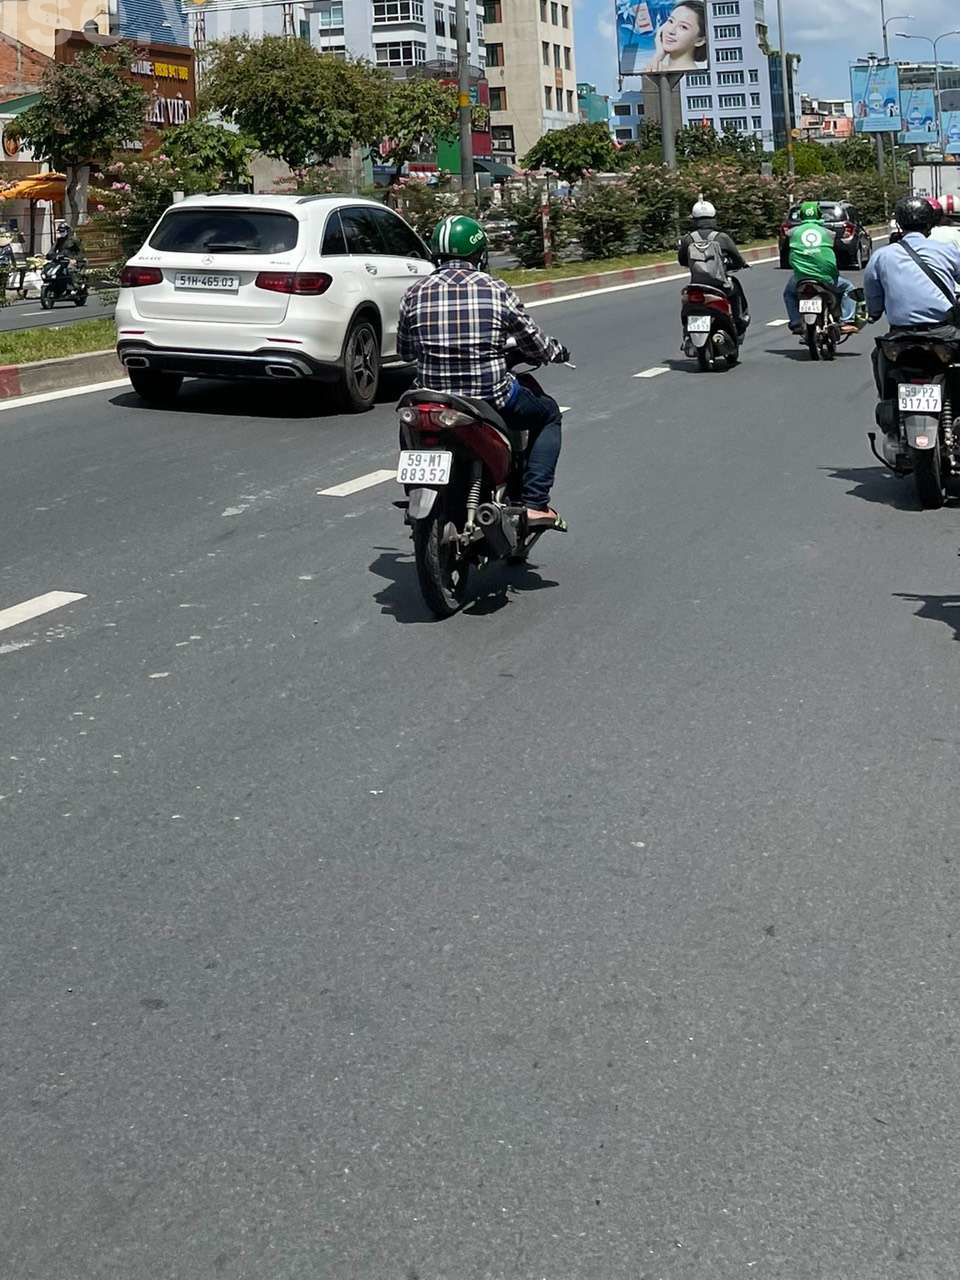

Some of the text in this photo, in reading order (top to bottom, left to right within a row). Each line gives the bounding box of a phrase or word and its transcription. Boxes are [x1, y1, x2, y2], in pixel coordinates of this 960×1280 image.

[180, 275, 234, 288] 51H-465.03
[902, 398, 938, 410] 917.17
[400, 468, 446, 482] 883.52
